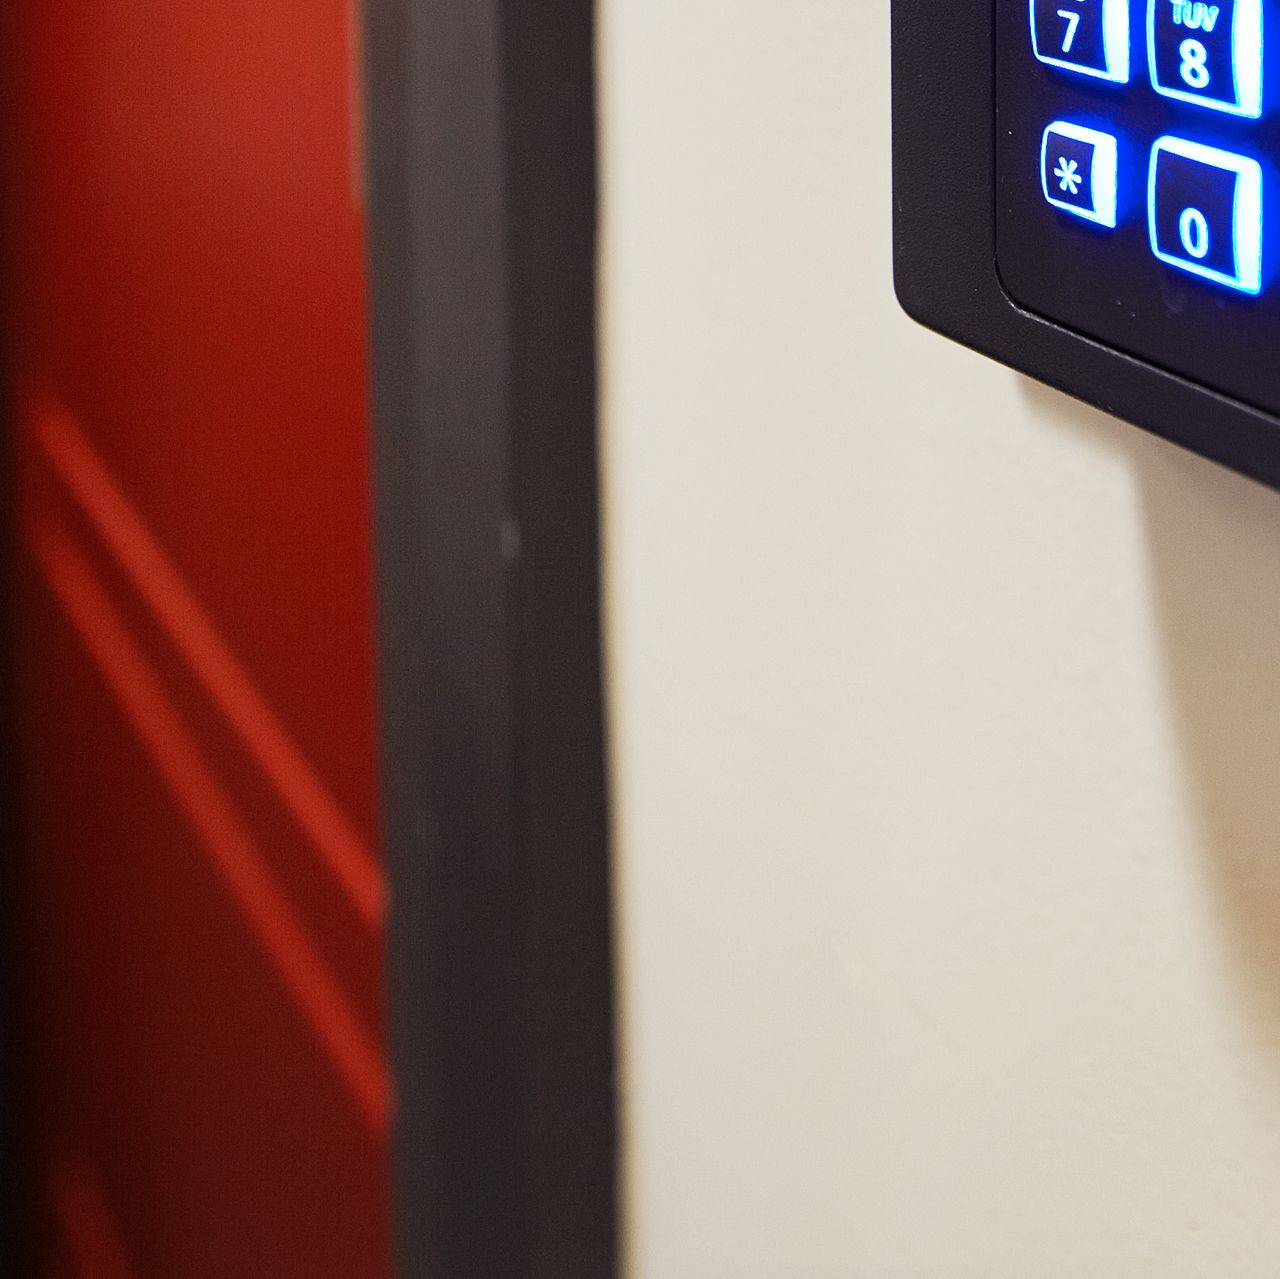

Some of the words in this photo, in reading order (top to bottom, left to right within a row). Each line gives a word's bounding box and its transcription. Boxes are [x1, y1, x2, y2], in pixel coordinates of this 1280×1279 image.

[1056, 9, 1081, 53] 7
[1178, 37, 1211, 89] 8
[1178, 207, 1210, 259] 0
